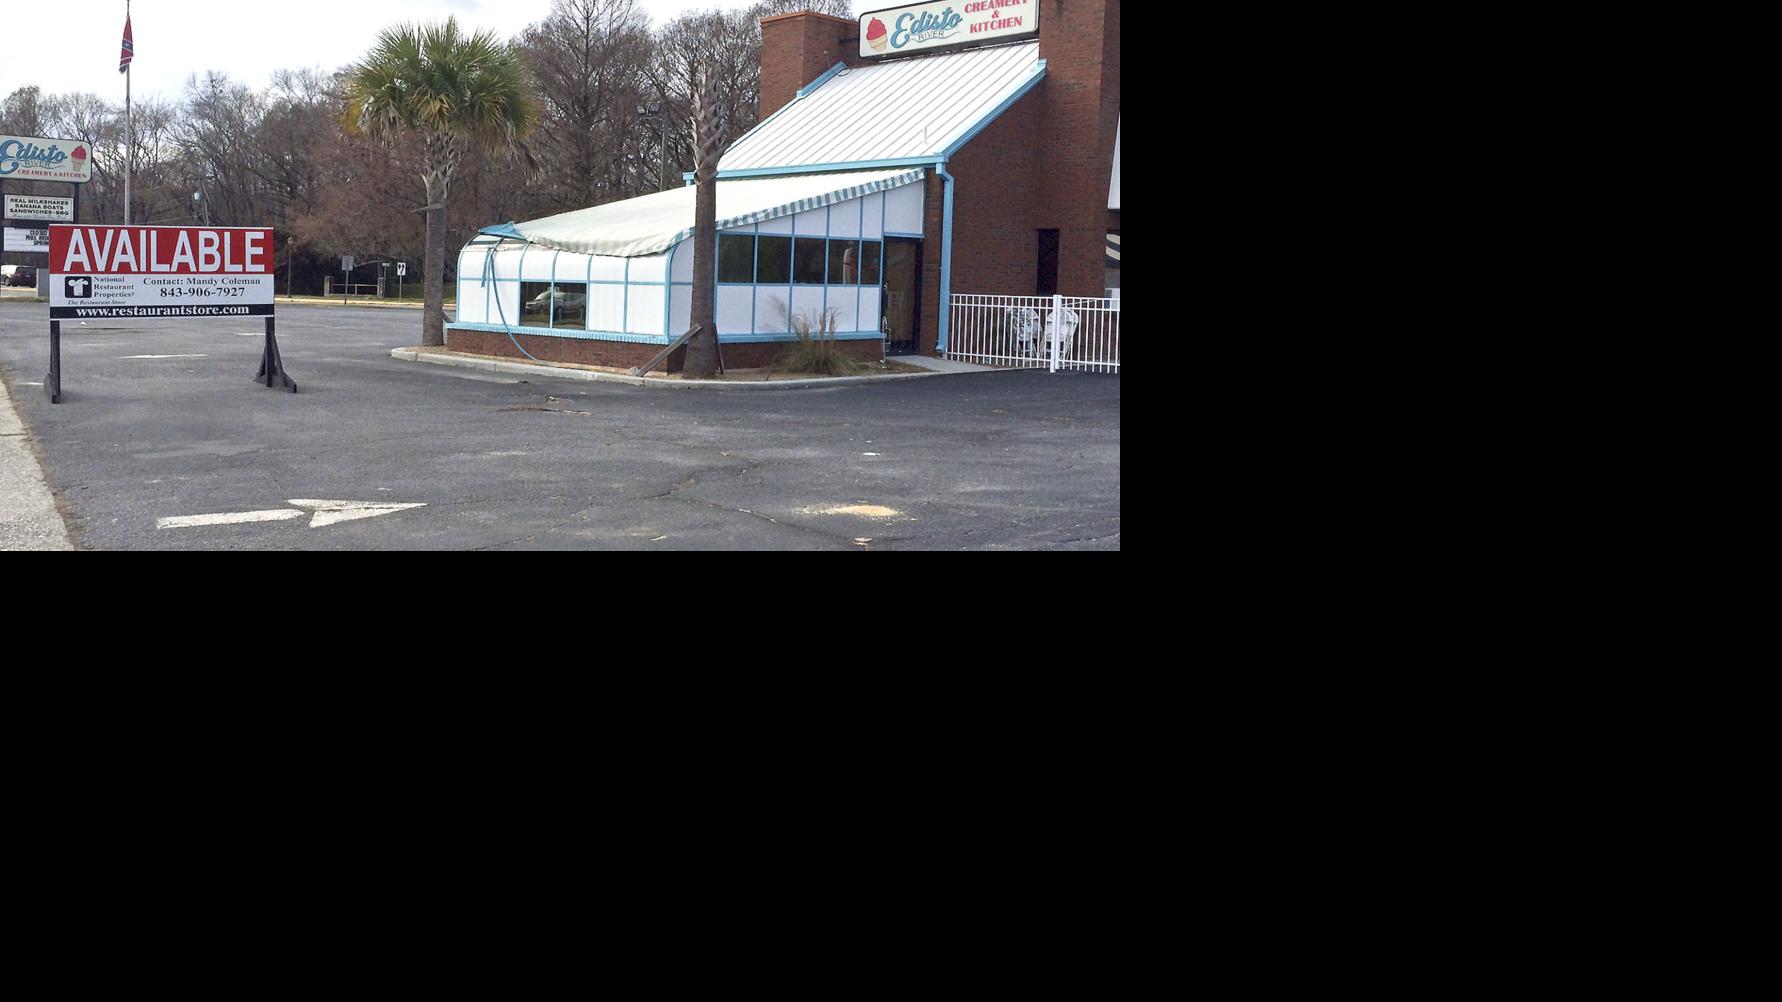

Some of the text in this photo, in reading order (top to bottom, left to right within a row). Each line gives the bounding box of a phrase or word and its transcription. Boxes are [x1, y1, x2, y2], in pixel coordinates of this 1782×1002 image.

[991, 10, 999, 19] &
[891, 7, 963, 48] Edisto
[970, 16, 1022, 33] KITCHEN
[918, 30, 945, 40] RIVER
[0, 140, 67, 174] Edisto
[24, 160, 51, 168] RIVER
[18, 169, 52, 177] CREAMERY
[63, 228, 265, 273] AVAILABLE
[143, 276, 261, 287] Contact: Mandy Coleman
[160, 287, 245, 297] 843-906-7927
[76, 305, 249, 316] www.restaurantstore.com
